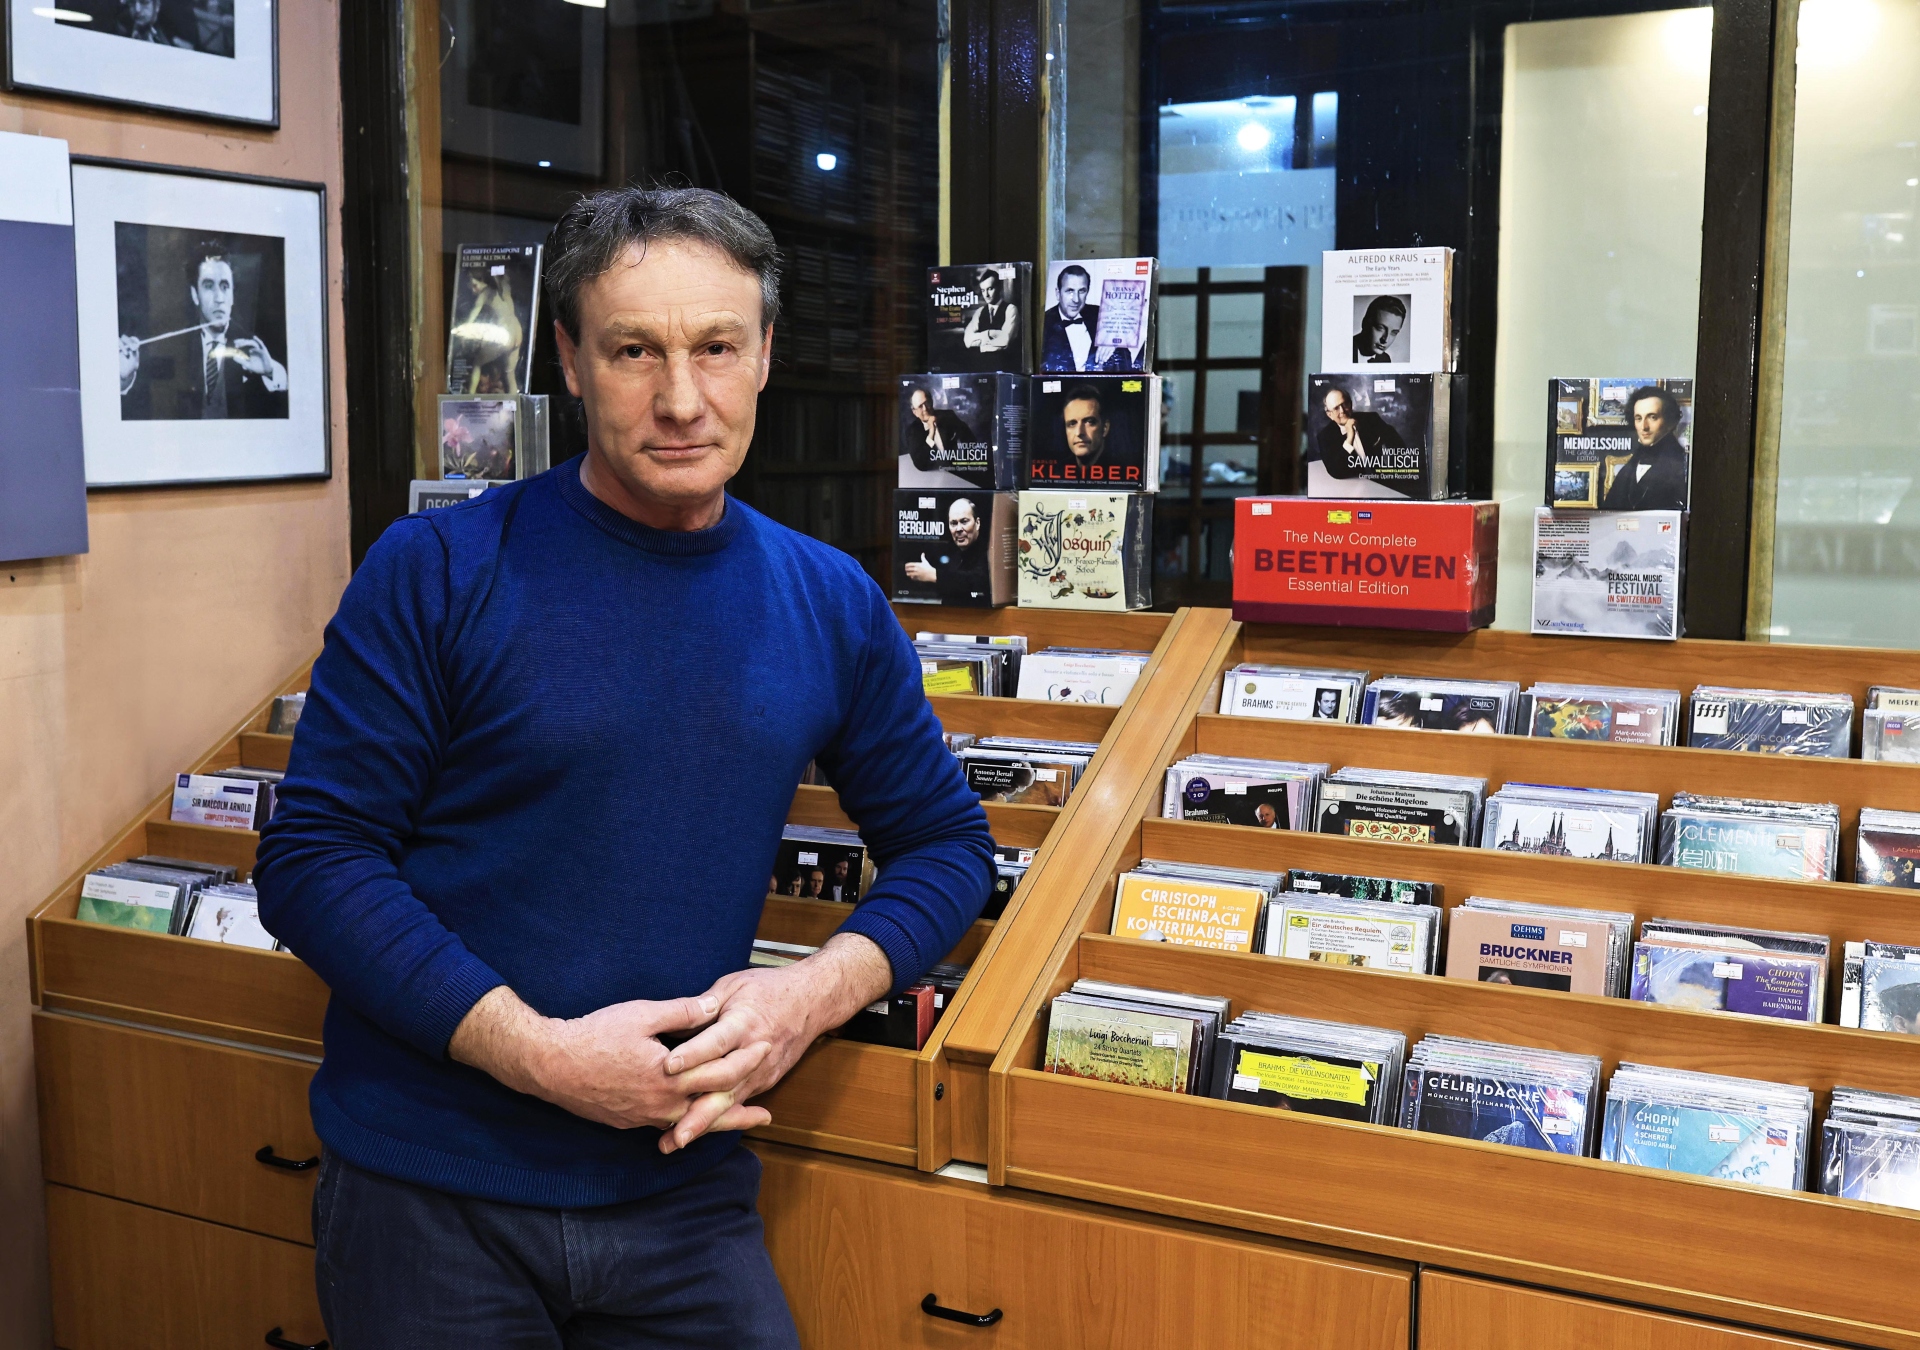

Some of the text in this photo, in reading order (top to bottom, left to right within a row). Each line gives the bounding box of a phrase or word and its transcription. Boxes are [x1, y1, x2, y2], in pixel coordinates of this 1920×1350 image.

[1348, 254, 1418, 264] ALFREDO KRAUS
[936, 286, 966, 294] Stephen
[931, 291, 979, 308] Hough
[1105, 292, 1140, 300] HOTTER
[957, 442, 988, 450] WOLFGANG
[1564, 436, 1632, 451] MENDELSSOHN
[930, 449, 988, 461] SAWALLISCH
[1382, 448, 1420, 456] WOLFGANG
[1348, 455, 1419, 468] SAWALLISCH
[1031, 464, 1140, 480] KLEIBER
[898, 510, 919, 520] PAAVO
[898, 521, 944, 536] BERGLUND
[1282, 530, 1417, 548] The New Complete
[1062, 556, 1072, 564] The
[1254, 548, 1456, 580] BEETHOVEN
[1608, 573, 1663, 583] CLASSICAL MUSIC
[1288, 577, 1409, 596] Essential Edition
[1608, 582, 1661, 596] FESTIVAL
[1608, 595, 1662, 605] IN SWITZERLAND
[1242, 698, 1274, 709] BRAHMS
[1696, 704, 1727, 718] ffff
[1614, 730, 1652, 738] Marc-Antoine
[1614, 736, 1646, 744] Charpentier
[974, 768, 995, 776] Antonio
[192, 798, 252, 813] SIR MALCOLM ARNOLD
[1394, 796, 1429, 806] Magelone
[204, 813, 224, 822] COMPLETE
[1185, 809, 1208, 817] Brahms
[1684, 825, 1772, 847] CLEMENTI
[1141, 888, 1217, 909] CHRISTOPH
[1152, 904, 1240, 927] ESCHENBACH
[1126, 916, 1225, 940] KONZERTHAUS
[1323, 924, 1354, 932] deutsches
[1354, 926, 1382, 934] Requiem
[1513, 925, 1543, 935] OEHMS
[1480, 943, 1573, 965] BRUCKNER
[1523, 961, 1573, 973] SYMPHONIEN
[1768, 968, 1805, 979] CHOPIN
[1755, 976, 1808, 988] The Complete
[1764, 984, 1804, 995] Nocturnes
[1778, 996, 1803, 1006] DANIEL
[1762, 1002, 1802, 1012] BARENBOIM
[1089, 1028, 1150, 1046] Luigi Boccherini
[1102, 1045, 1119, 1054] String
[1120, 1046, 1142, 1057] Quartets
[1258, 1062, 1286, 1072] BRAHMS
[1289, 1066, 1299, 1074] DIE
[1300, 1067, 1351, 1082] VIOLINSONATEN
[1258, 1079, 1281, 1088] UGUSTIN
[1281, 1082, 1300, 1090] DUMAY
[1302, 1086, 1320, 1094] MARIA
[1411, 1081, 1418, 1090] 2
[1428, 1076, 1541, 1103] CELIBIDACHE
[1427, 1087, 1469, 1103] MÜNCHNER
[1636, 1111, 1680, 1128] CHOPIN
[1640, 1124, 1673, 1134] BALLADES
[1640, 1132, 1668, 1142] SCHERZI
[1633, 1139, 1657, 1148] CLAUDIO
